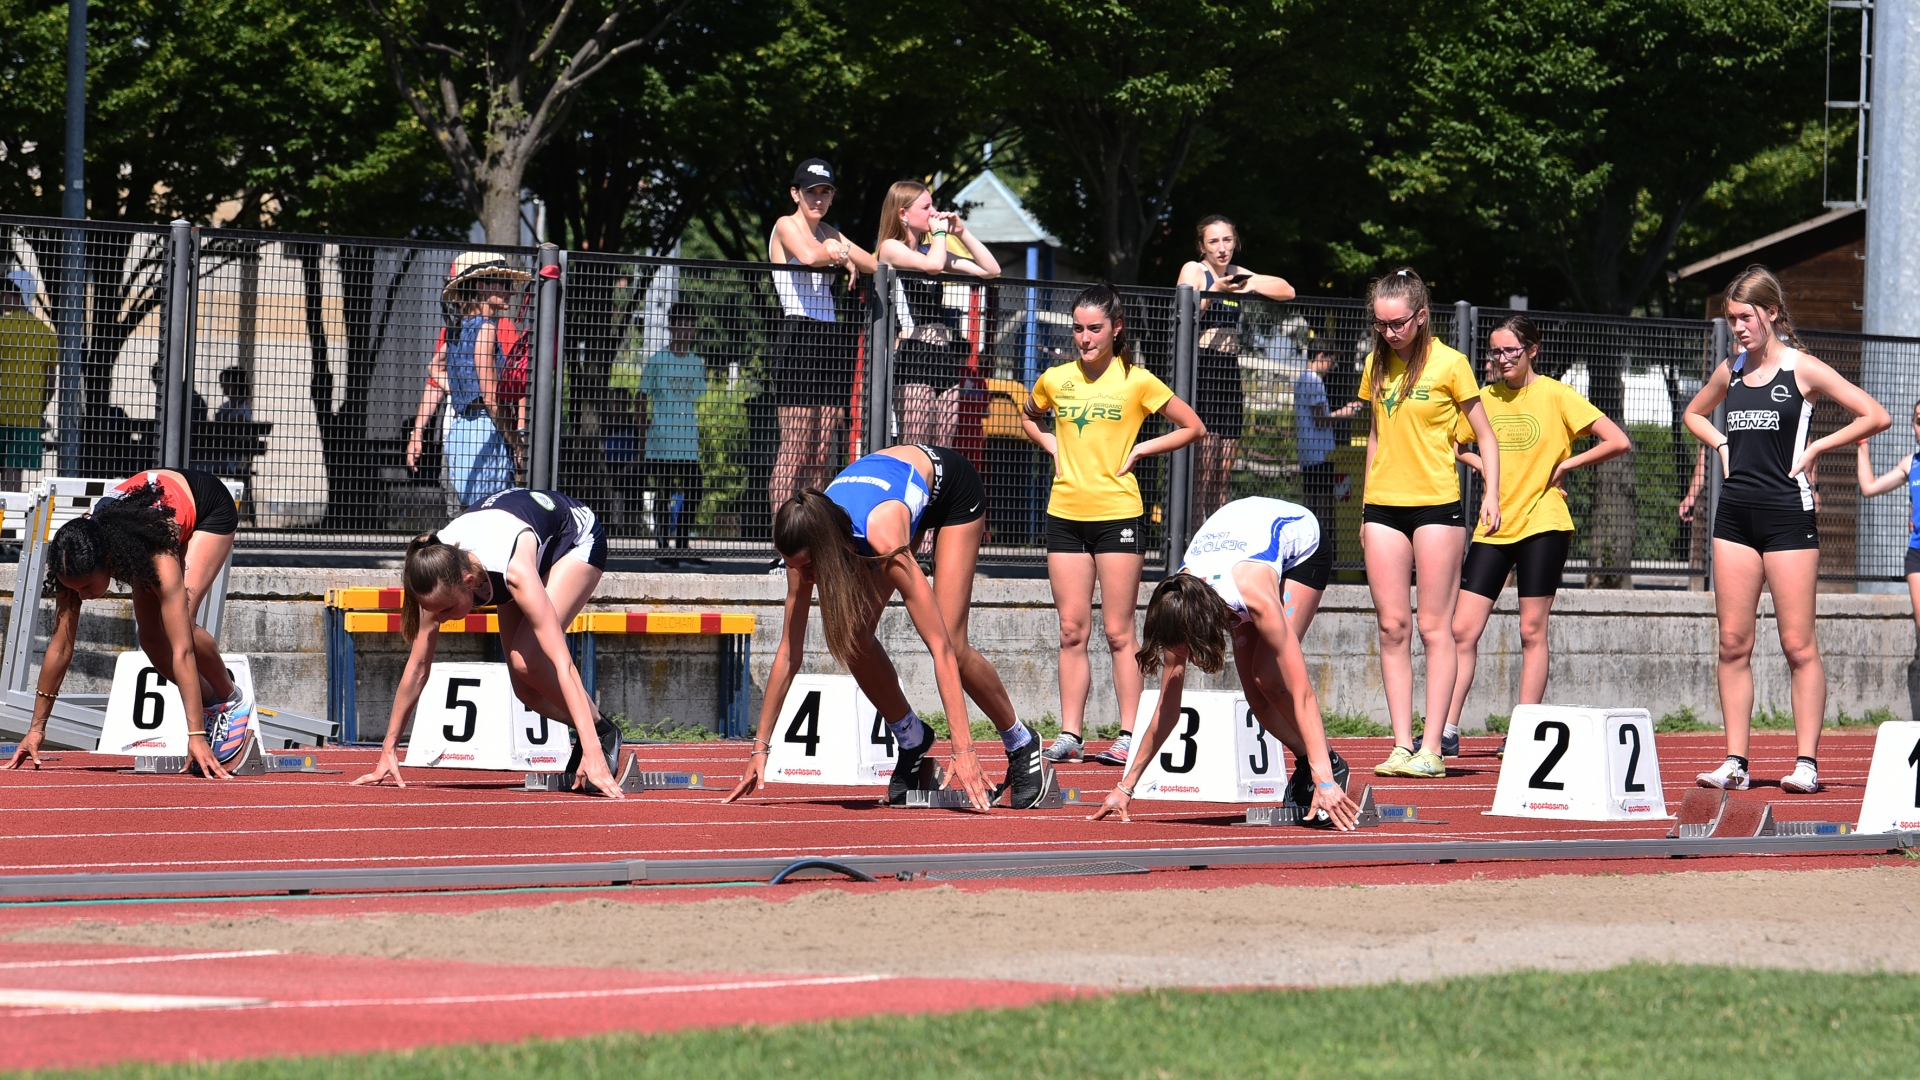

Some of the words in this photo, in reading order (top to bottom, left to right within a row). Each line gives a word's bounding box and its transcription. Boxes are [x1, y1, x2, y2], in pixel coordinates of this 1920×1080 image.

[1093, 402, 1123, 410] BERGAMO
[1727, 411, 1779, 420] ATLETICA
[1728, 419, 1779, 430] MONZA
[928, 463, 943, 507] NIKE
[133, 666, 168, 730] 6
[442, 677, 481, 743] 5
[784, 691, 822, 757] 4
[871, 706, 895, 757] 4
[1160, 706, 1200, 774] 3
[1246, 708, 1270, 775] 3
[1528, 720, 1571, 791] 2
[1619, 723, 1646, 793] 2
[279, 758, 302, 766] MONDO
[783, 768, 821, 777] sportissimo
[667, 776, 689, 784] MONDO
[1159, 785, 1200, 794] sportissimo
[1529, 802, 1569, 811] sportissimo
[1383, 808, 1404, 817] MONDO
[1816, 825, 1838, 834] MONDO
